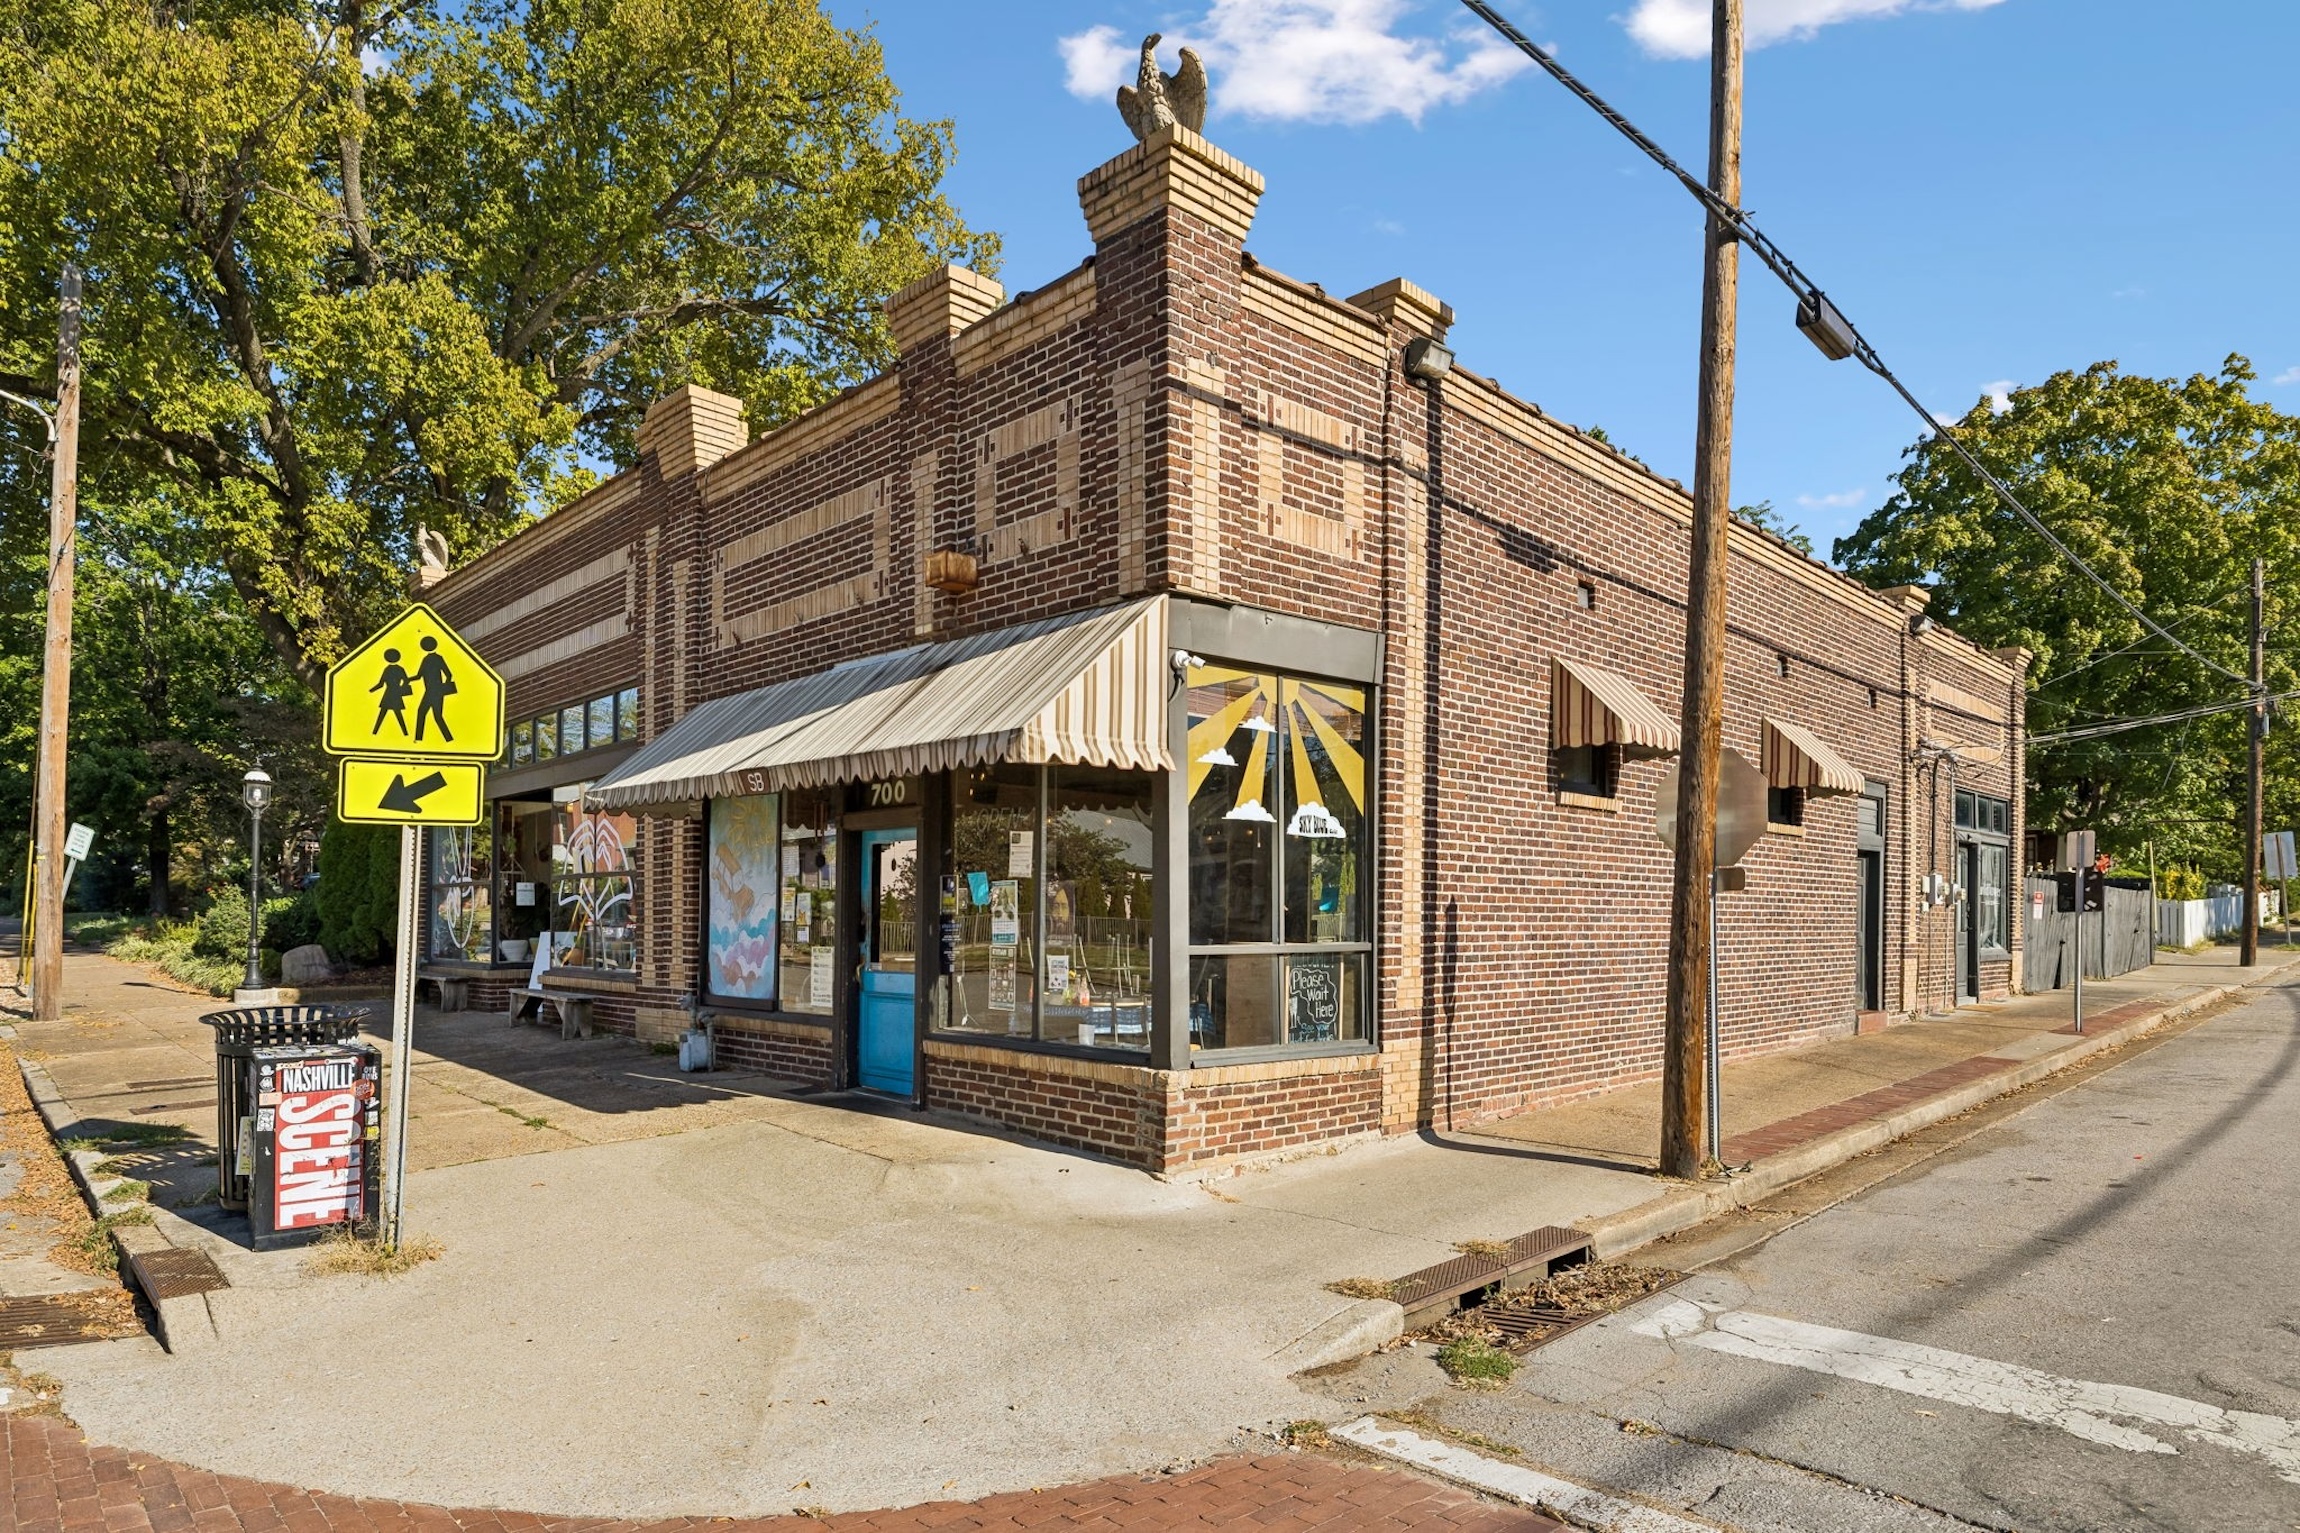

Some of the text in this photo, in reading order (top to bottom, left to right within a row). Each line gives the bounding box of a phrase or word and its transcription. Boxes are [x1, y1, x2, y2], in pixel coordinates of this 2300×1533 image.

[747, 772, 765, 792] SB
[871, 780, 906, 806] 700
[1299, 814, 1312, 834] SKY
[1313, 815, 1328, 834] BLUE
[1292, 970, 1325, 990] Please
[1315, 1001, 1335, 1018] Here
[283, 1063, 355, 1093] NASHVILLE
[278, 1093, 362, 1227] SCENE
